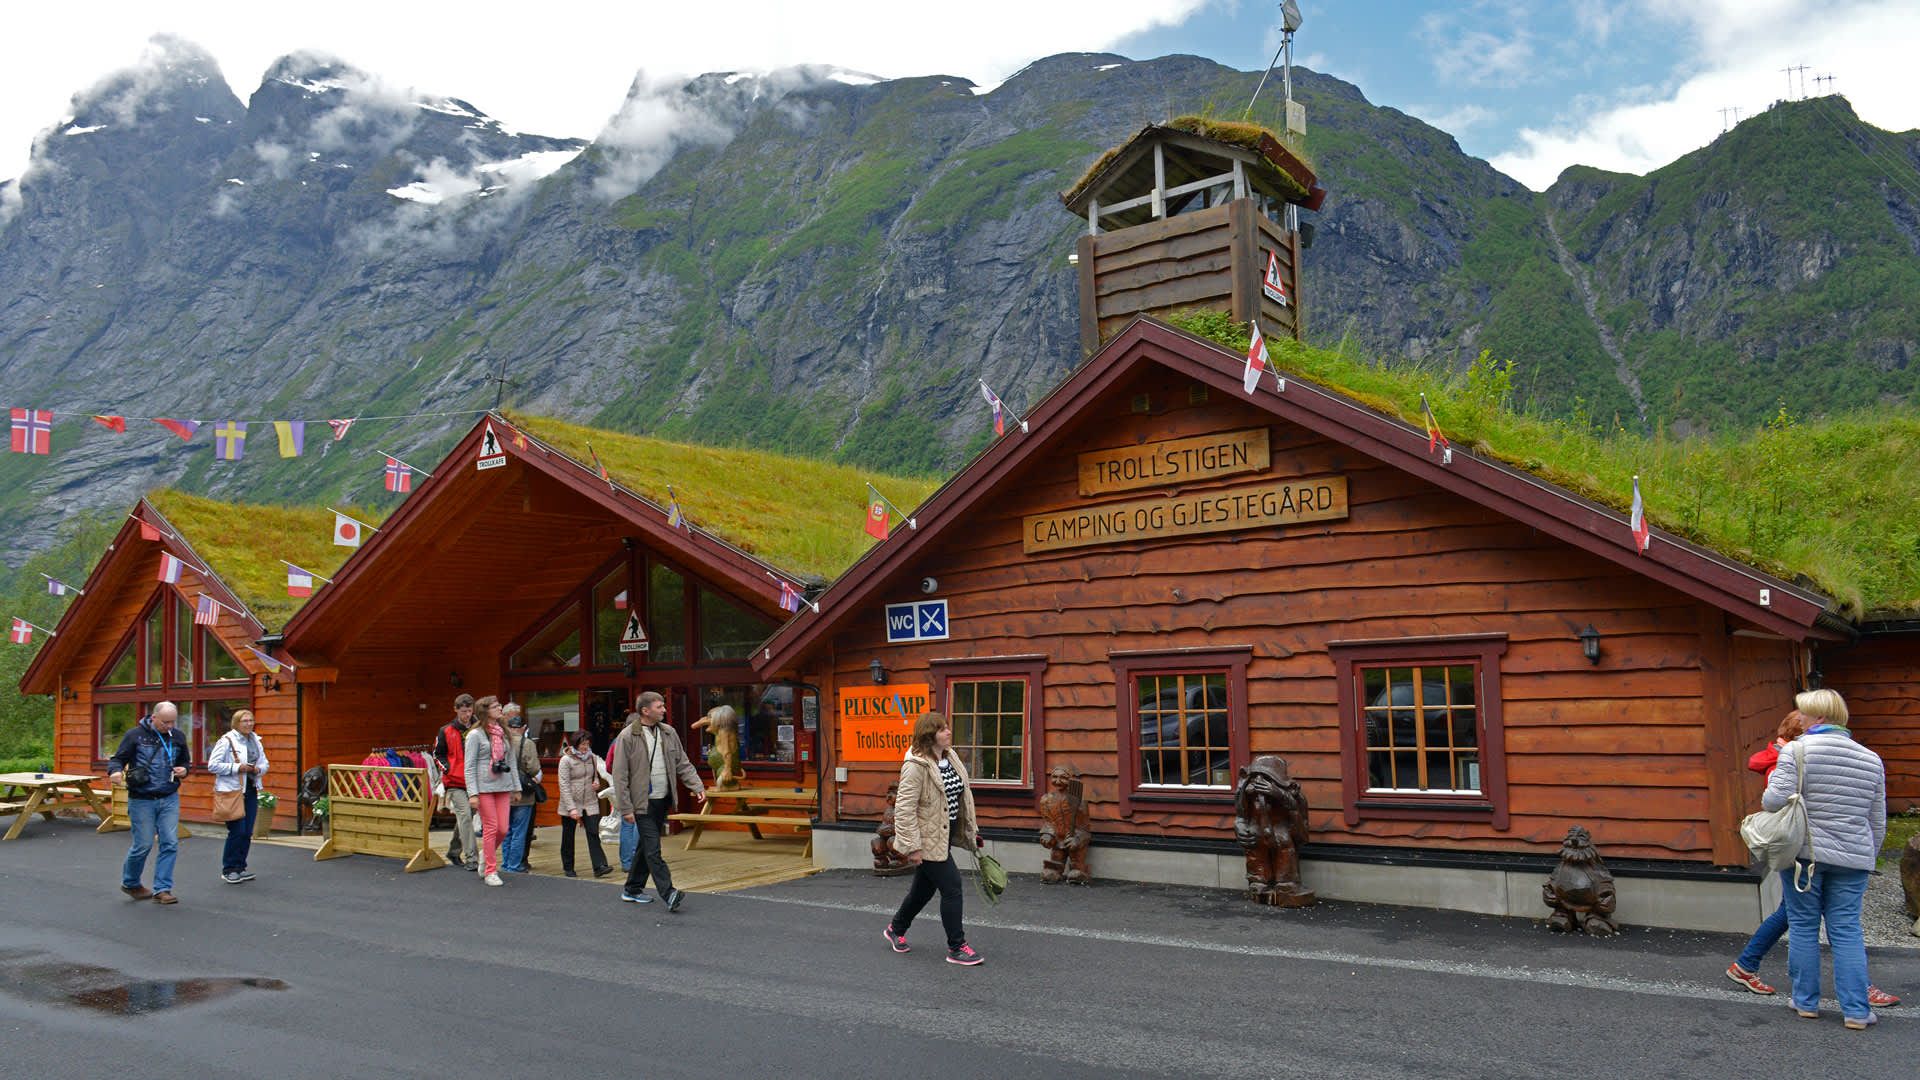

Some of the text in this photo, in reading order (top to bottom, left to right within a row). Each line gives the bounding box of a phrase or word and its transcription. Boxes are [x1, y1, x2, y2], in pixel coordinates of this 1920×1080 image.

[1096, 442, 1248, 484] TROLLSTIGEN
[1034, 486, 1333, 543] CAMPING OG GJESTEGÅRD
[890, 615, 914, 630] WC
[844, 693, 925, 718] PLUSCAMP
